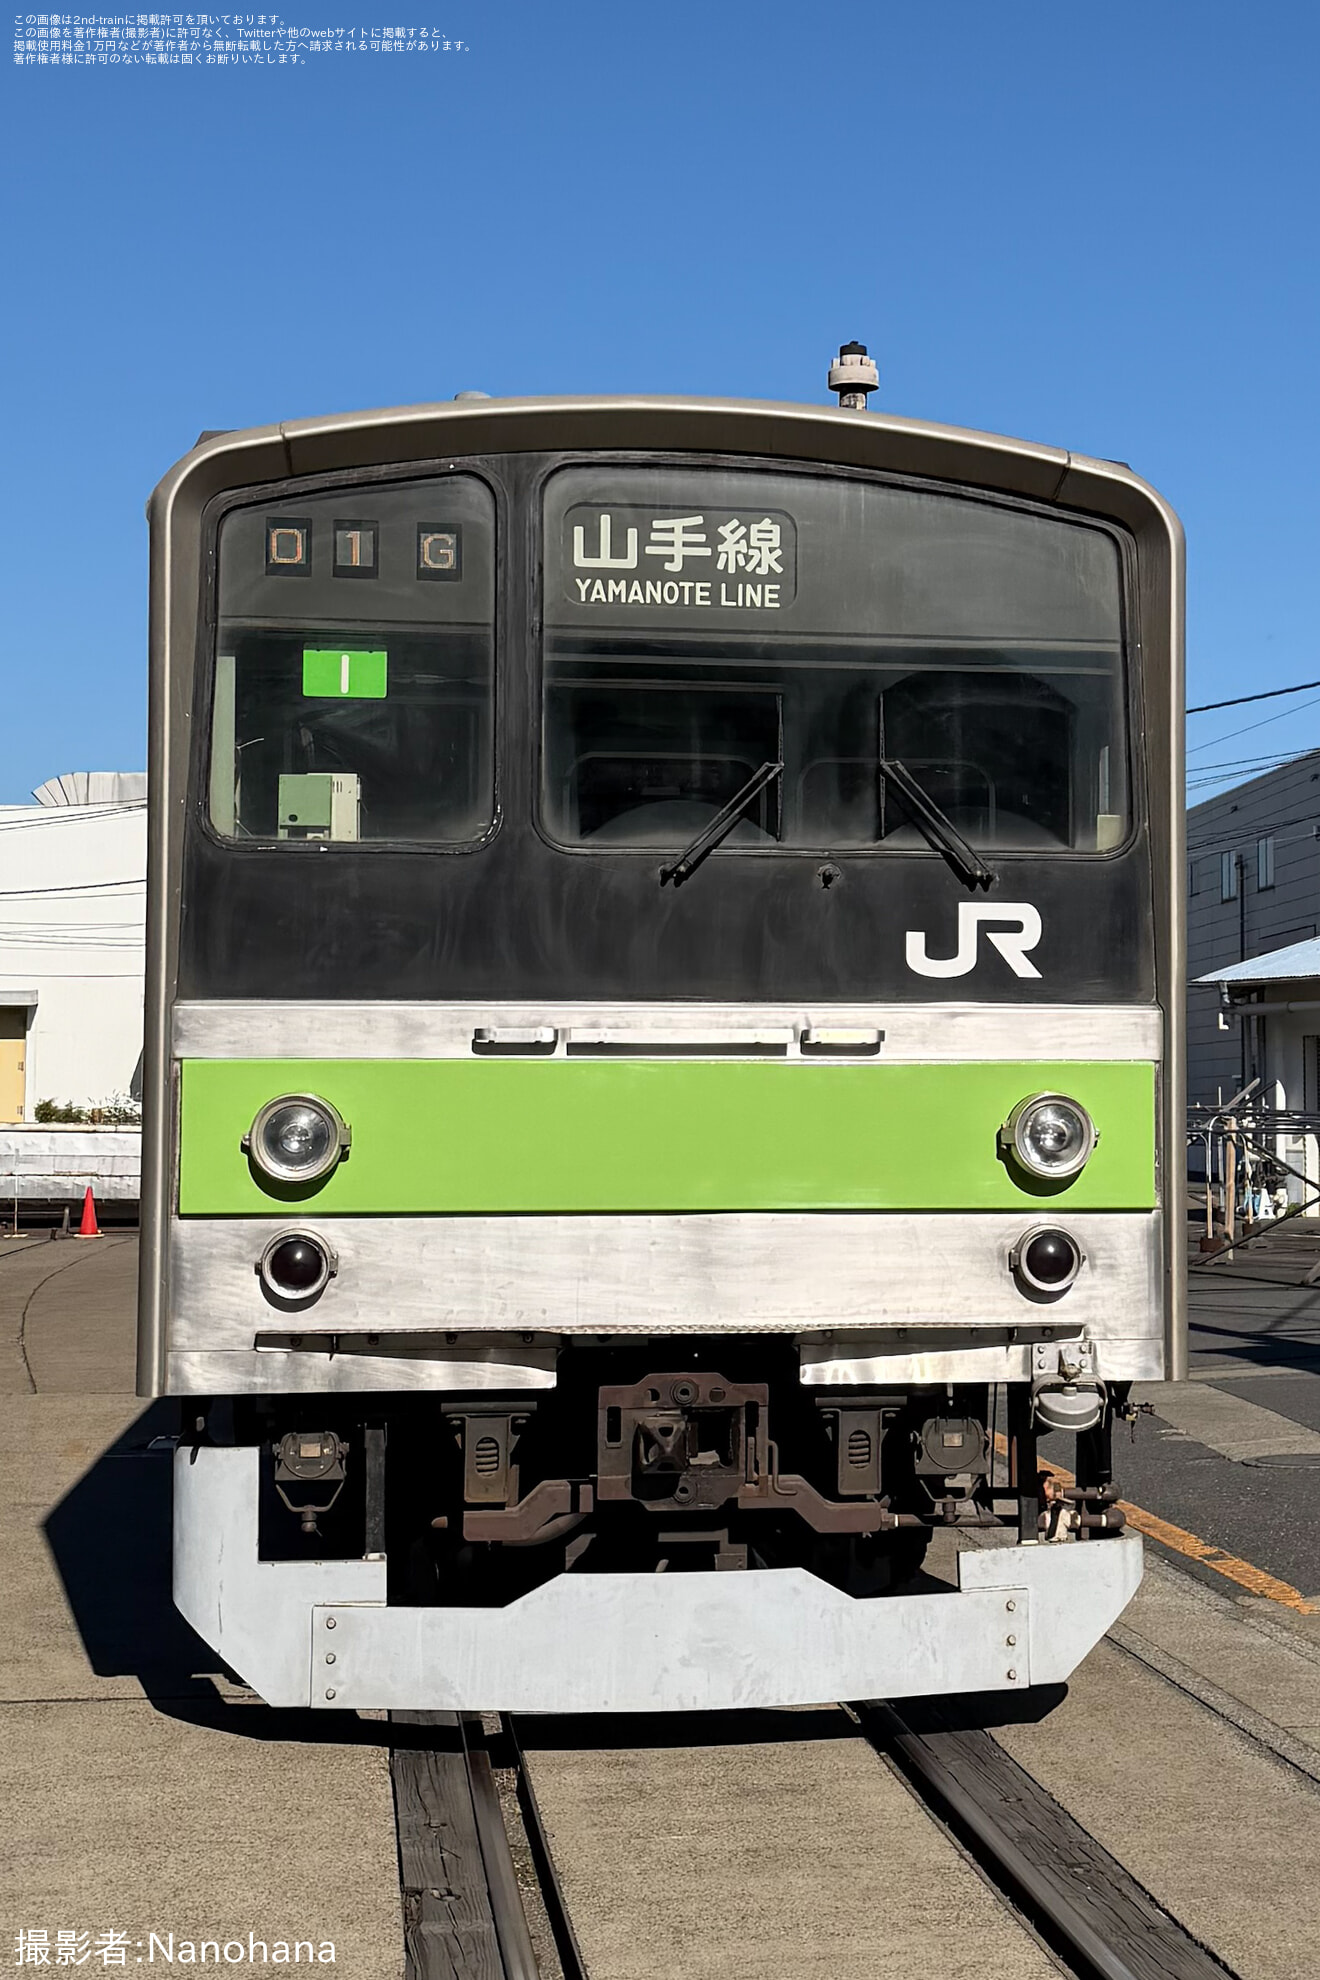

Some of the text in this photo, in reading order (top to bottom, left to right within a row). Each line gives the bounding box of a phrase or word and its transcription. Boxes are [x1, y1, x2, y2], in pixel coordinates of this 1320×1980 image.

[423, 533, 455, 570] G
[573, 513, 784, 575] 山手線
[575, 578, 781, 608] YAMANOTE LINE
[905, 901, 1043, 979] JR
